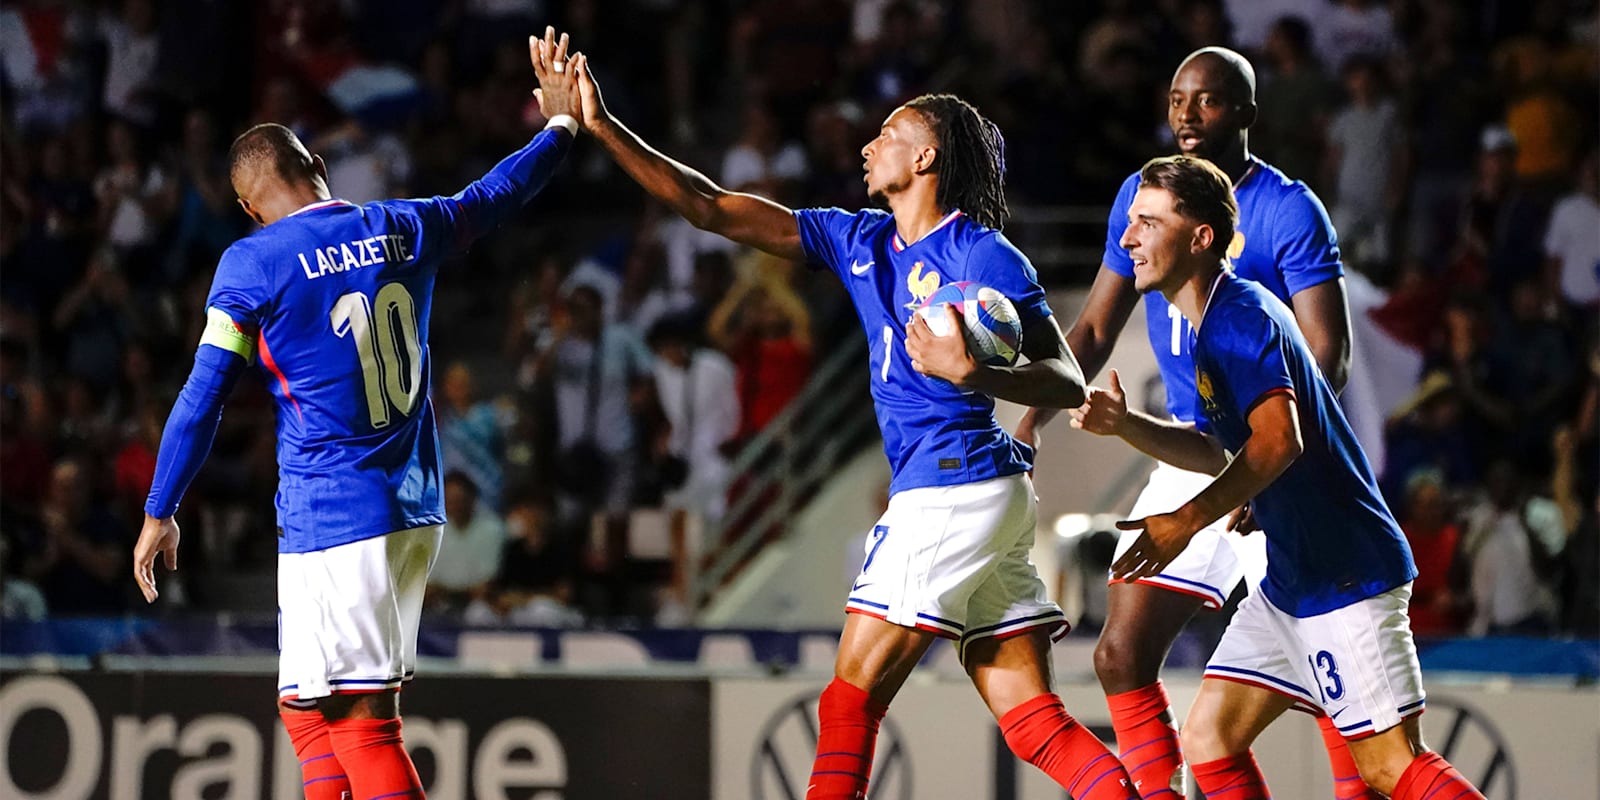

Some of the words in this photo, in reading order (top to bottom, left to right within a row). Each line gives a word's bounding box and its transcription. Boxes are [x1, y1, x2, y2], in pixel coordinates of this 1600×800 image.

[298, 234, 414, 279] LACAZETTE
[330, 282, 422, 429] 10
[1168, 303, 1197, 356] 1
[863, 524, 890, 575] 7
[1308, 650, 1346, 705] 13
[0, 675, 568, 800] Orae
